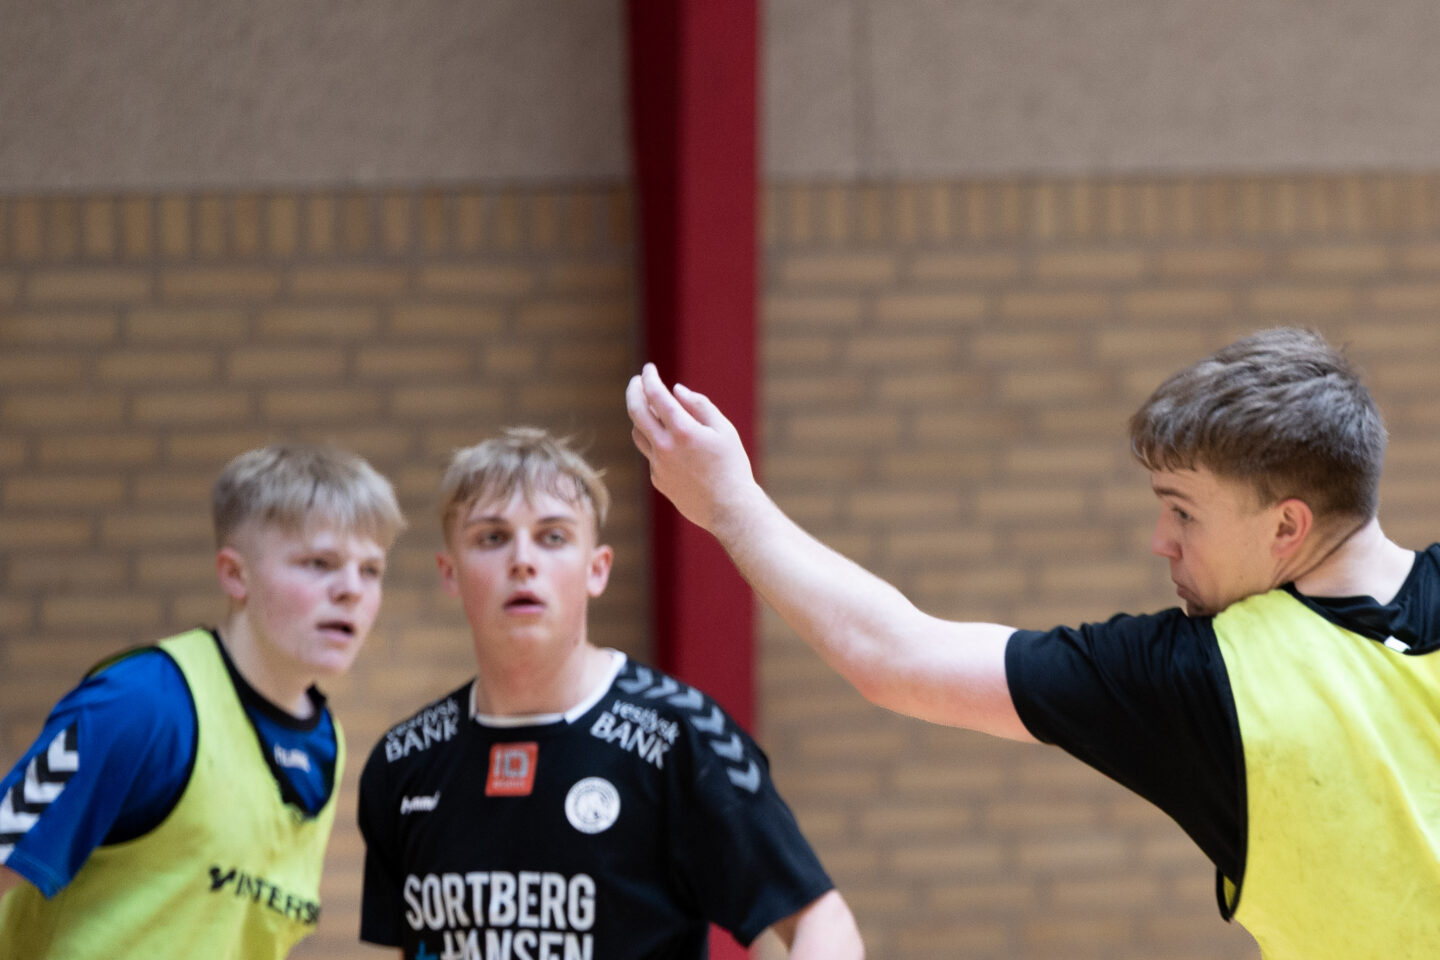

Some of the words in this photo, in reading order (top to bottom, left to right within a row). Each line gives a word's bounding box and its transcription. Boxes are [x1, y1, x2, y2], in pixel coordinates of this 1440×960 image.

[385, 716, 458, 763] BANK
[590, 711, 671, 770] BANK
[235, 871, 321, 925] INTERS
[403, 871, 596, 931] SORTBERG
